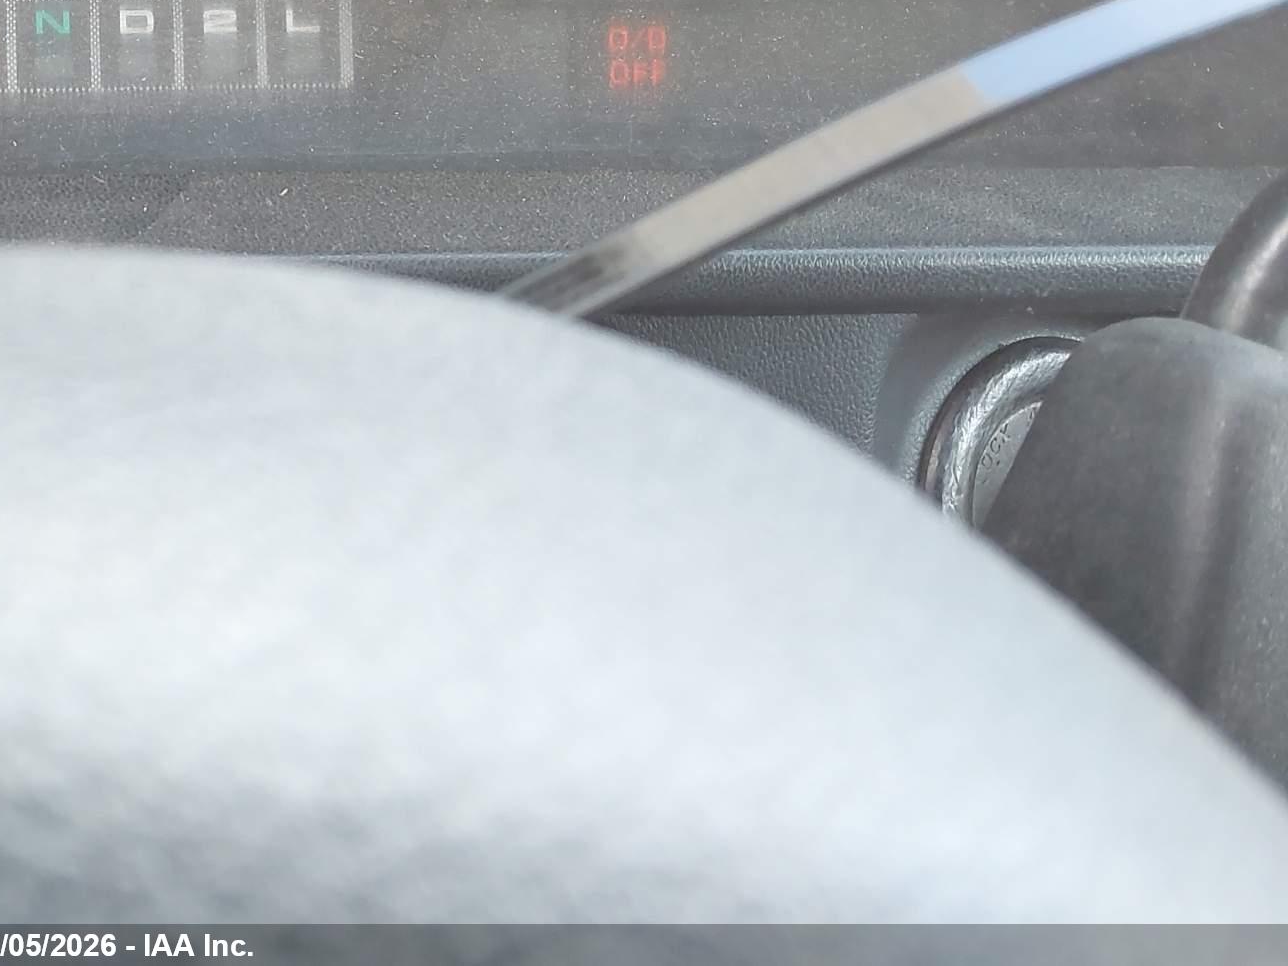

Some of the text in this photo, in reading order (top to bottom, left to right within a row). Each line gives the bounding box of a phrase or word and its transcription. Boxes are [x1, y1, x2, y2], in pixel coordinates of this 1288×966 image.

[34, 9, 71, 34] N
[119, 9, 154, 35] D
[203, 9, 238, 35] 2
[286, 8, 321, 34] L
[609, 60, 665, 89] OFF
